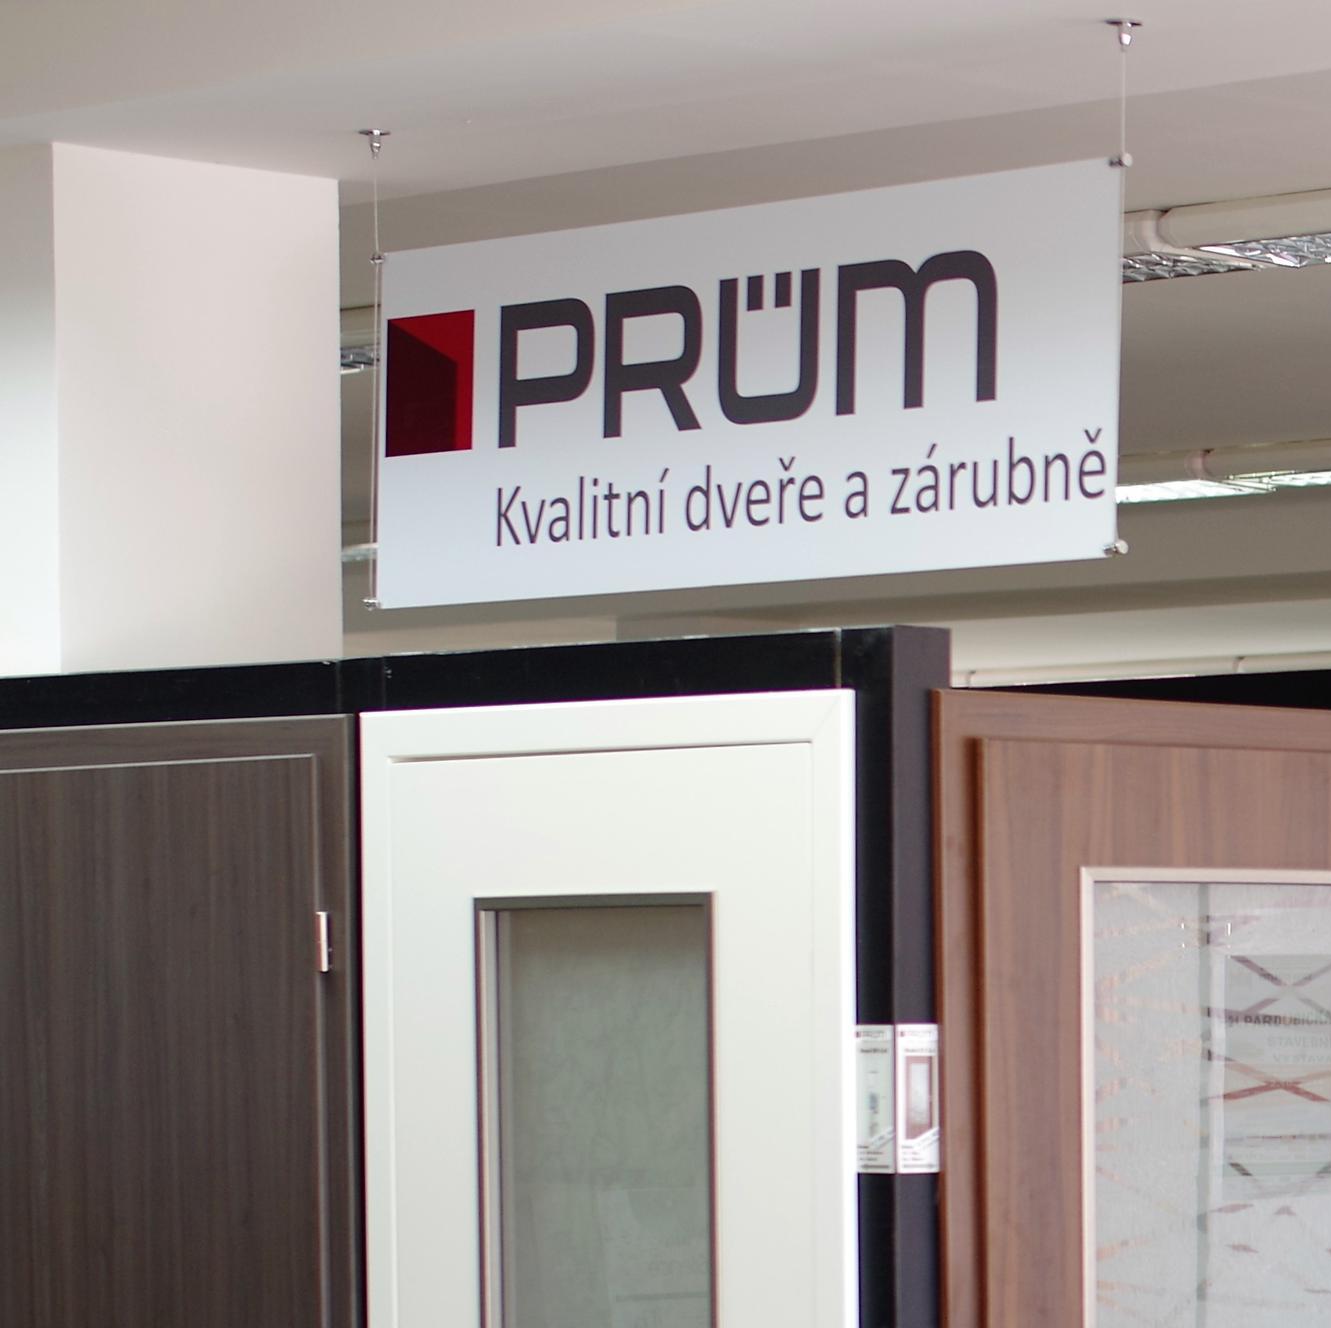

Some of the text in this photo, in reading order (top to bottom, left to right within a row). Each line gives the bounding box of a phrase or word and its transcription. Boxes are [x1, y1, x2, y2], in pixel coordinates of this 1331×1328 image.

[495, 428, 1107, 547] Kvalitní dveře a zárubně
